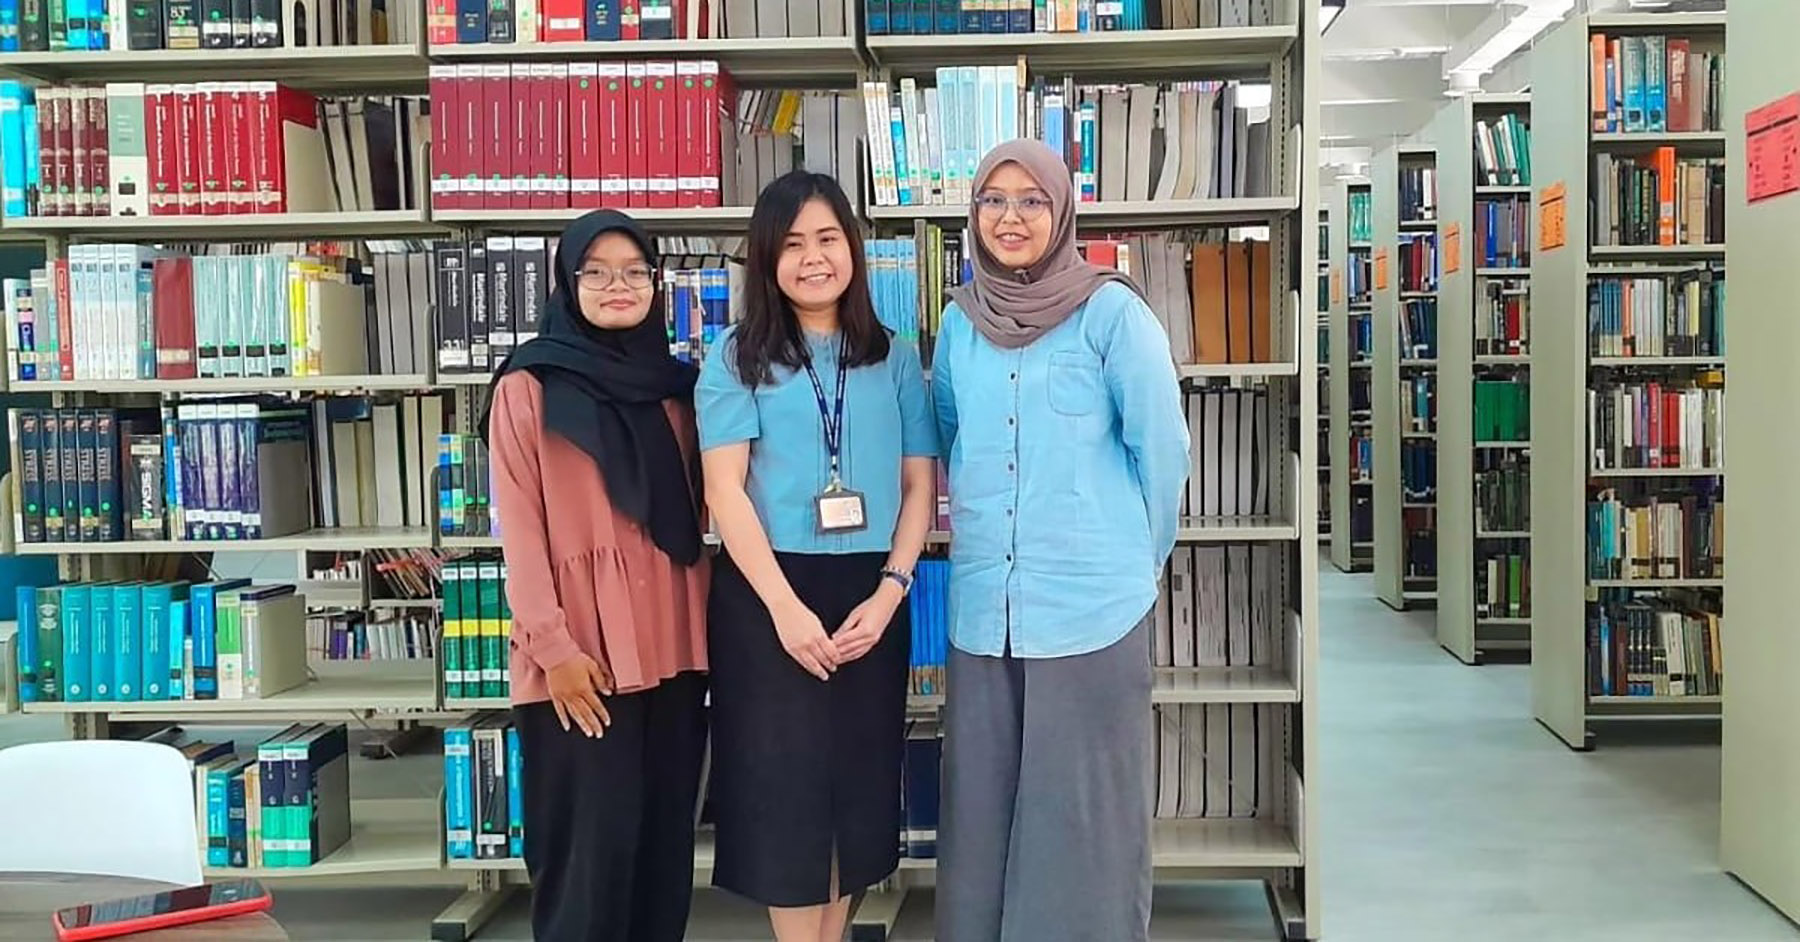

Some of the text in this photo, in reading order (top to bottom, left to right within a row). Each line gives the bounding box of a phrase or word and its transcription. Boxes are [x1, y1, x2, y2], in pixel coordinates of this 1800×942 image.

[477, 272, 487, 323] Martindale
[499, 272, 509, 323] Martindale
[528, 272, 538, 323] Martindale
[141, 472, 153, 521] SIGMA
